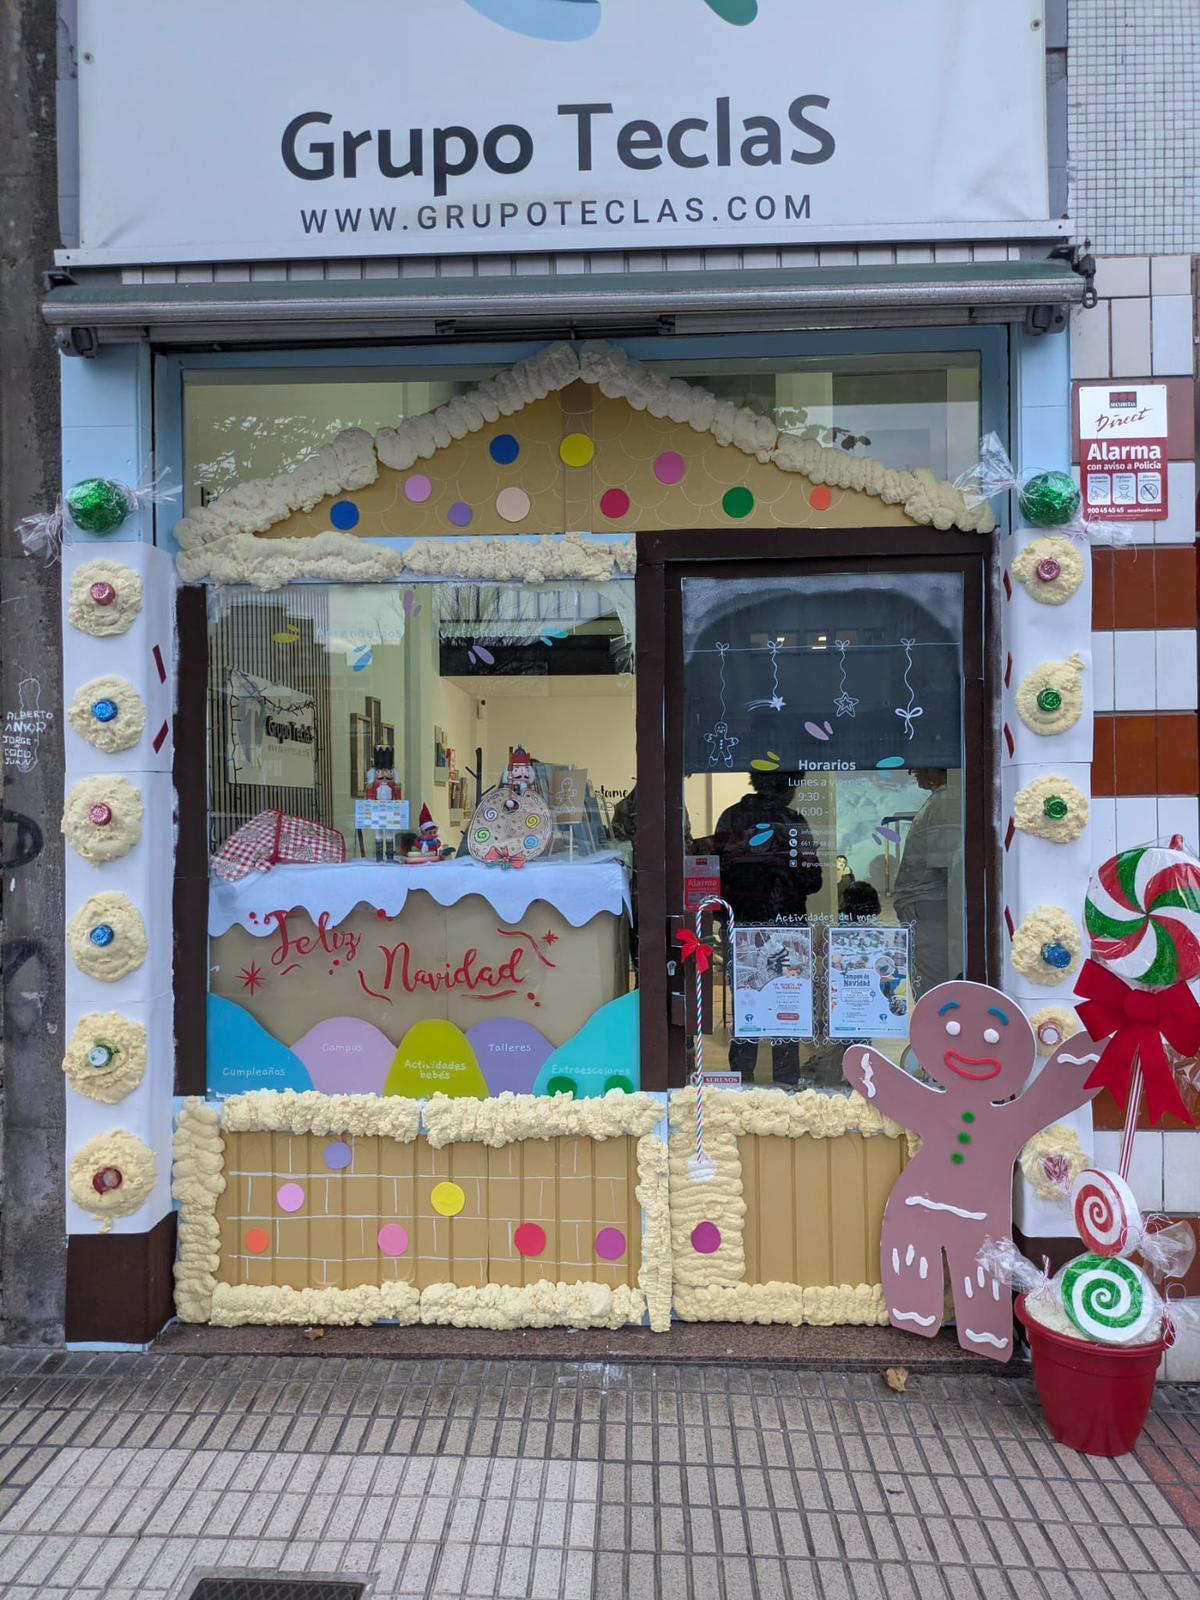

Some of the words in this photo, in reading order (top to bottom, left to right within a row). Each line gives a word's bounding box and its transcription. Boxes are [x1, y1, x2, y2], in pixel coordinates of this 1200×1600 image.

[281, 111, 534, 197] Grupo
[557, 94, 836, 171] TeclaS
[300, 194, 812, 234] WWW.GRUPOTECLAS.COM
[1095, 408, 1153, 432] Direct
[1087, 442, 1161, 460] Alarma
[1087, 463, 1102, 471] con
[1103, 462, 1126, 470] aviso
[7, 711, 53, 720] ALBERTO
[798, 759, 857, 770] Horarios
[788, 777, 818, 787] Lunes
[820, 779, 827, 787] a
[798, 791, 820, 801] 9:30
[795, 807, 823, 817] 16:00
[775, 912, 834, 923] Actividades
[838, 912, 853, 921] del
[264, 909, 362, 966] Feliz
[376, 942, 525, 992] Navidad
[321, 1043, 363, 1055] Campus
[488, 1043, 532, 1052] Talleres
[404, 1059, 467, 1071] Actividades
[551, 1064, 631, 1076] Extraescolares
[222, 1067, 286, 1078] Cumpleaños
[420, 1069, 451, 1080] bebés
